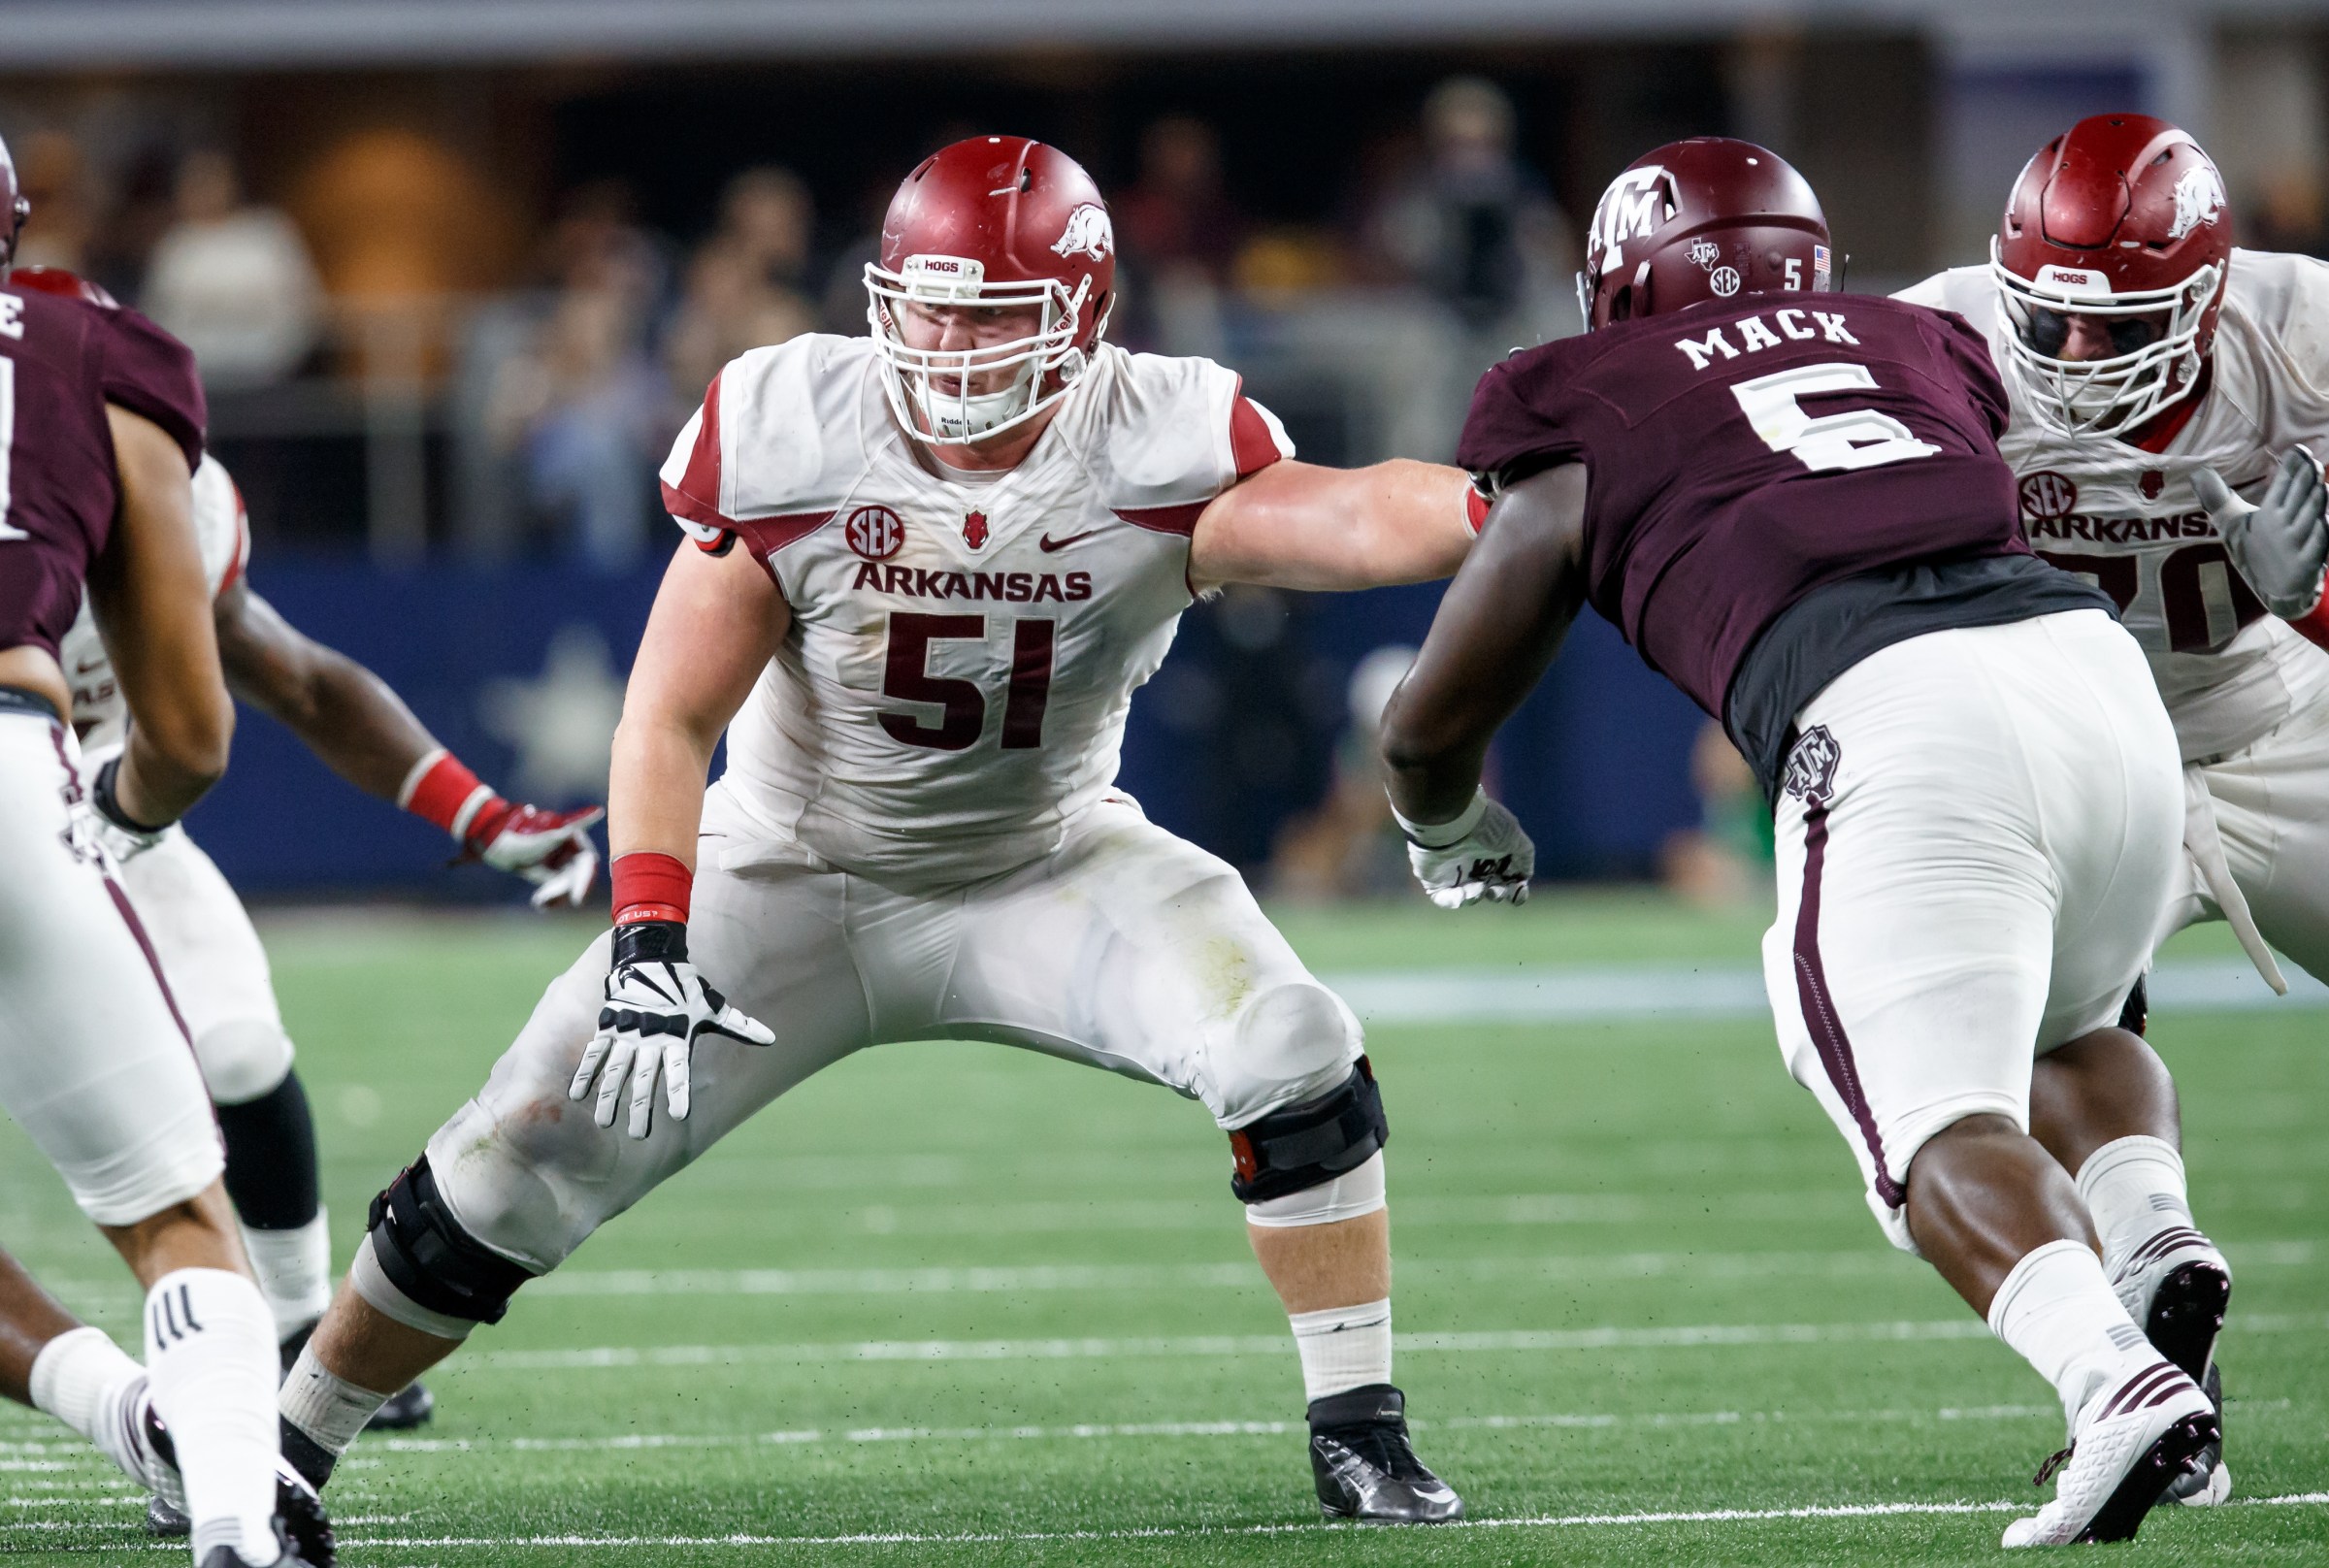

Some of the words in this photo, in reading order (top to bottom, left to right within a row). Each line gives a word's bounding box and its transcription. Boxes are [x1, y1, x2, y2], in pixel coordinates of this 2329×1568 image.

[925, 260, 959, 273] HOGS
[1714, 269, 1738, 295] SEC
[1784, 258, 1801, 291] 5
[2052, 272, 2087, 284] HOGS
[1674, 309, 1860, 371] MACK
[2021, 473, 2075, 516] SEC
[850, 508, 901, 557] SEC
[2032, 511, 2219, 543] ARKANS
[852, 561, 1093, 604] ARKANSAS
[876, 609, 1059, 753] 51
